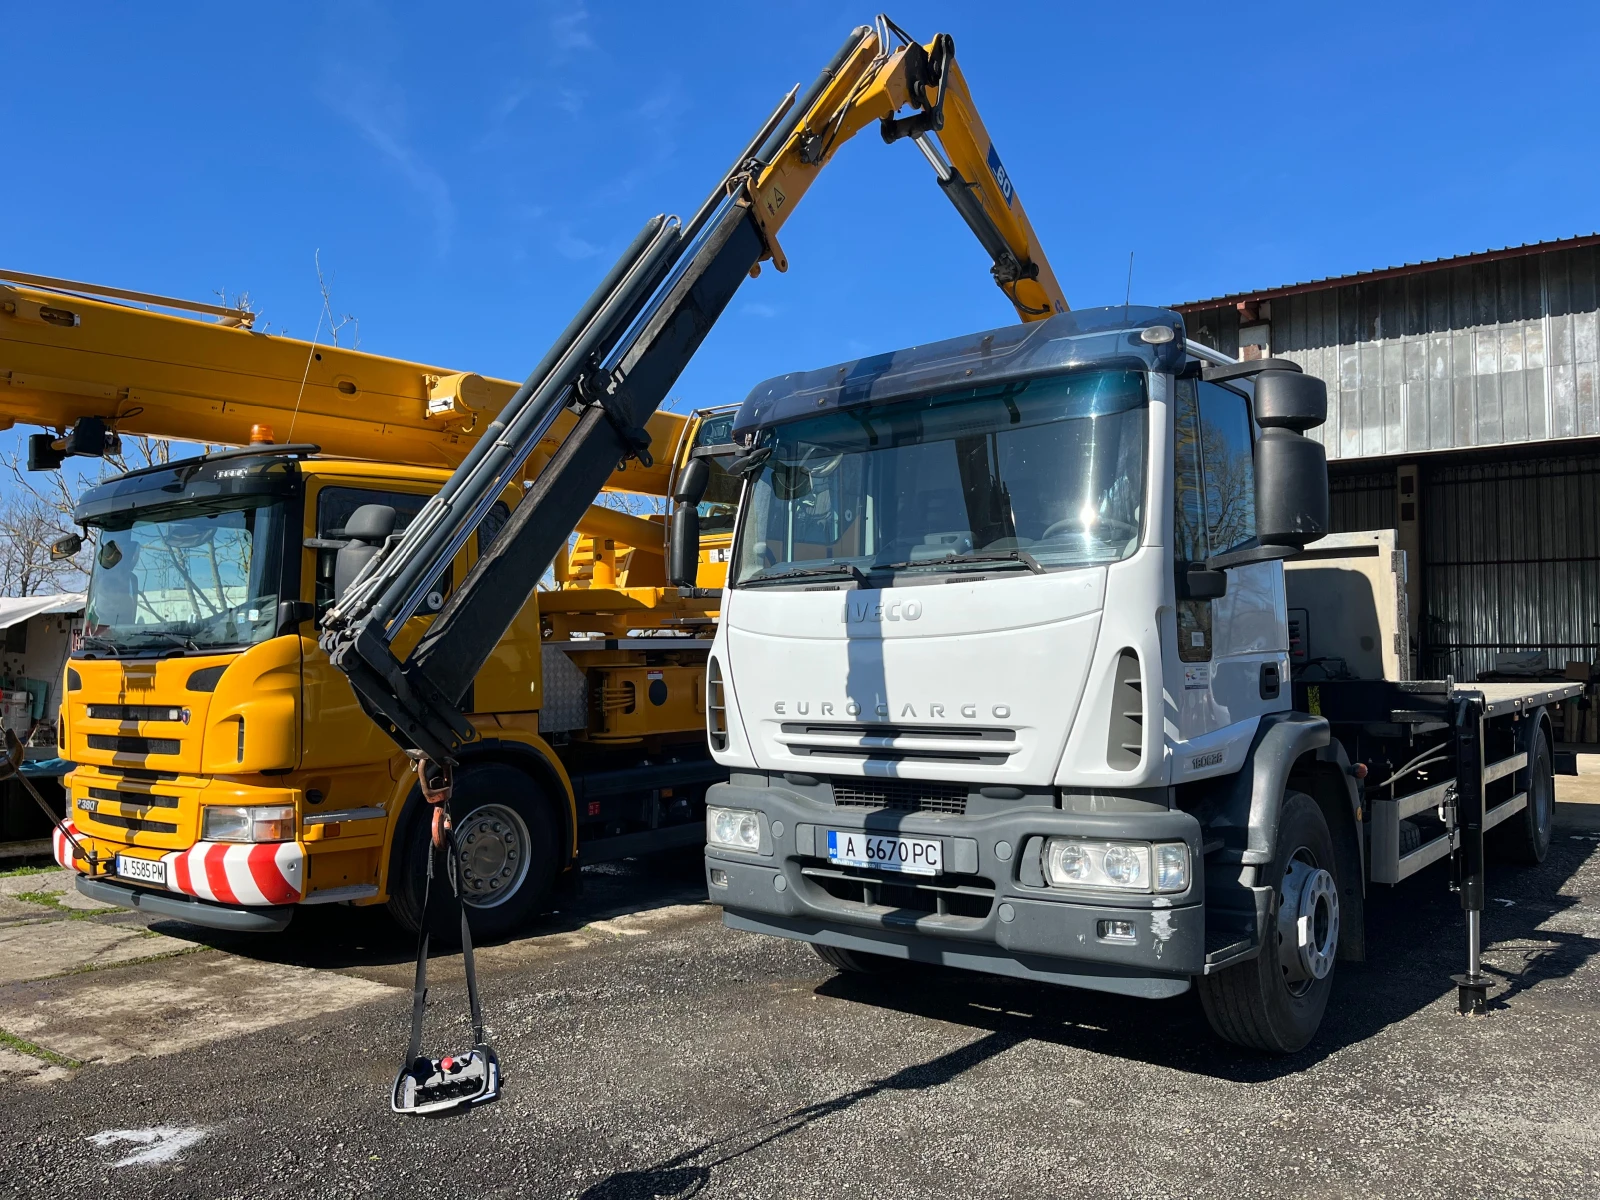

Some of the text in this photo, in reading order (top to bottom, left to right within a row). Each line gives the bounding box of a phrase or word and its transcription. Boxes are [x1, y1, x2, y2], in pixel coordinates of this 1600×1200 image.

[840, 598, 923, 623] IVECO
[773, 700, 1012, 719] EUROCARGO
[846, 836, 856, 857] A
[123, 858, 129, 875] A
